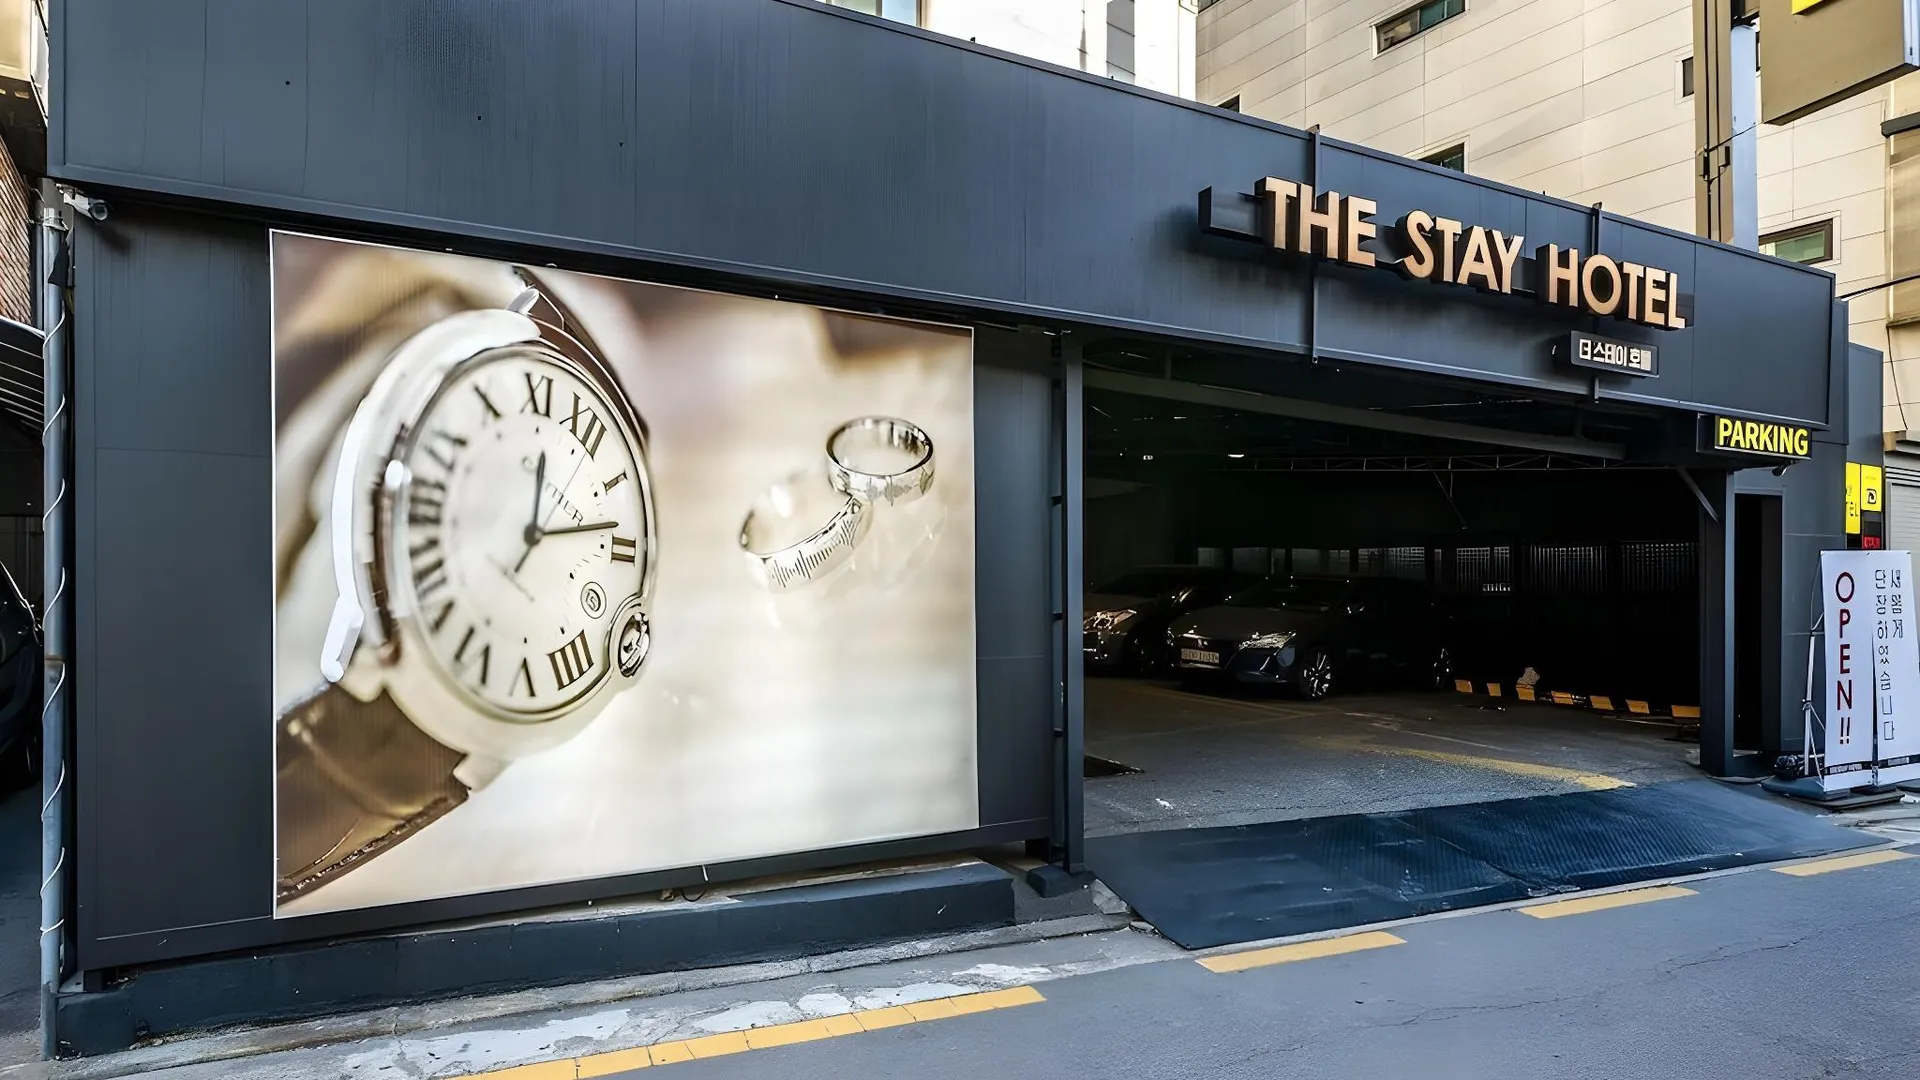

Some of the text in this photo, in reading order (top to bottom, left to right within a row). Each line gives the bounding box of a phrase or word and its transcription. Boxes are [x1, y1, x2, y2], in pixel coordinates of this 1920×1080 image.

[1265, 176, 1686, 329] THE STAY HOTEL
[1579, 338, 1592, 361] 더
[1628, 347, 1652, 371] 호
[1719, 417, 1809, 456] PARKING
